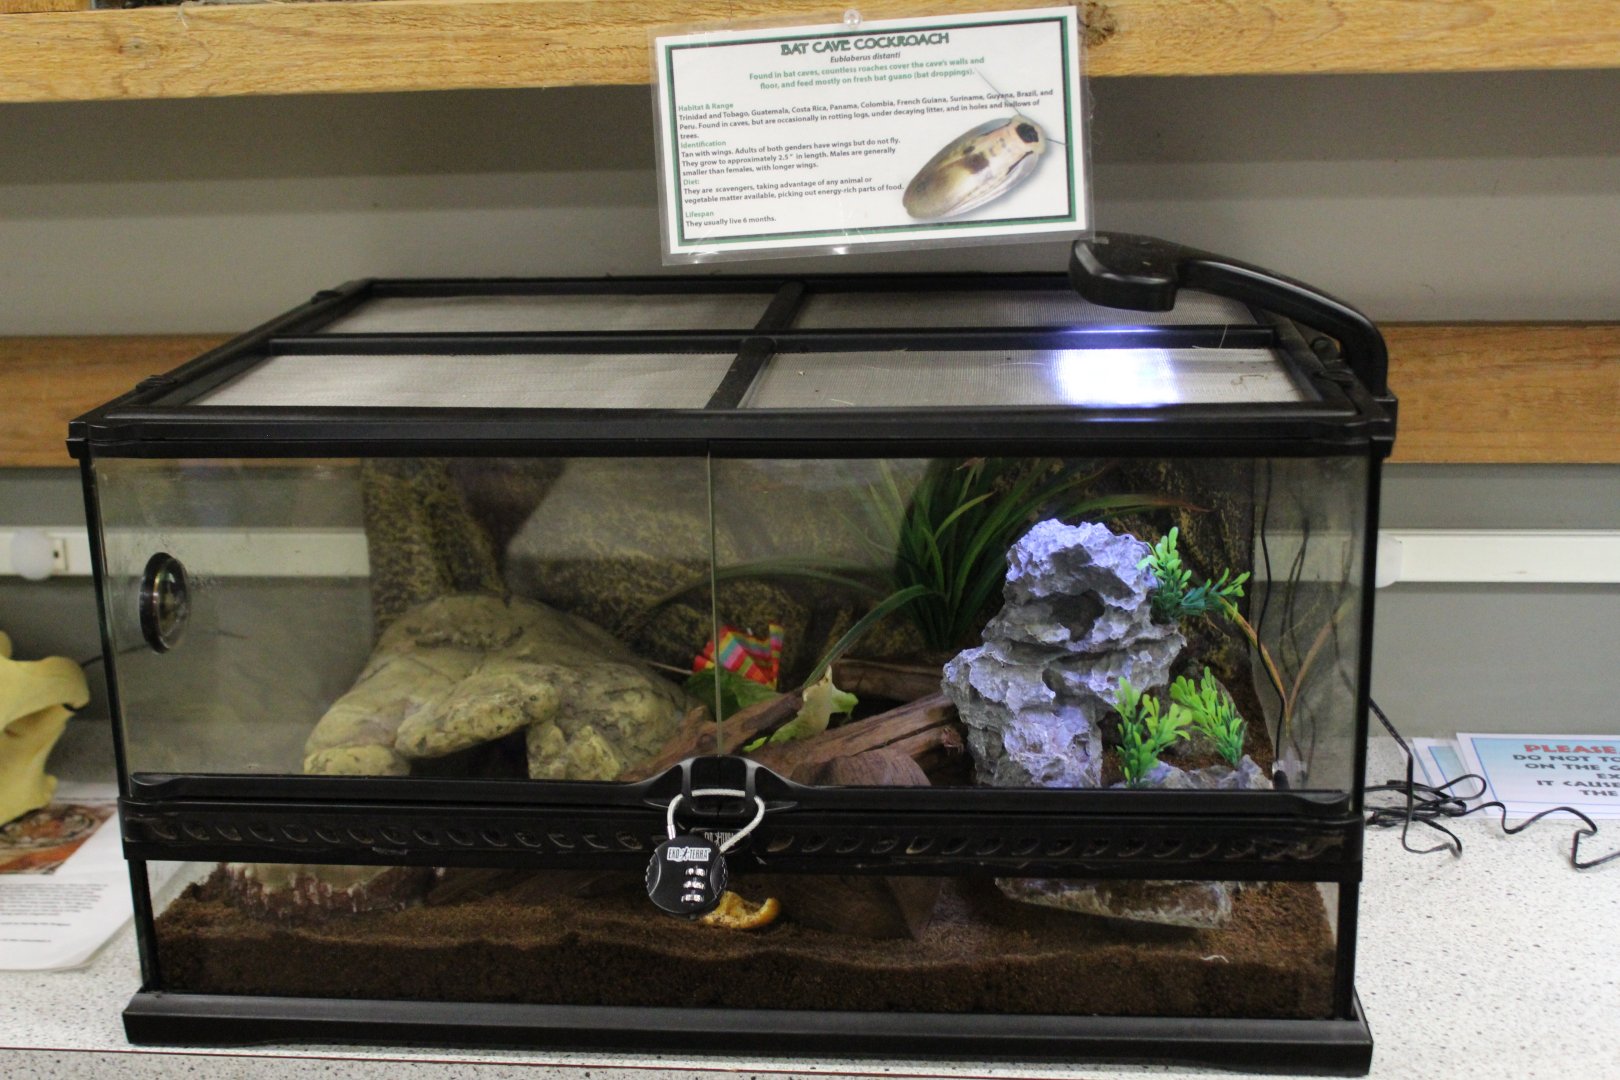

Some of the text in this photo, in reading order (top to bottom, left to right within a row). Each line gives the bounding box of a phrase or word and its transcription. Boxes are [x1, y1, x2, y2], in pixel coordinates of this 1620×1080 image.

[781, 32, 949, 55] BAT CAVE COCKROACH
[830, 51, 900, 63] Eublaberus distanti
[749, 71, 772, 80] Found
[783, 70, 795, 78] bat
[821, 66, 856, 75] countless
[858, 63, 887, 72] roaches
[911, 60, 923, 69] the
[925, 59, 947, 68] cave's
[949, 57, 967, 66] walls
[970, 56, 984, 65] and
[759, 81, 779, 89] floor,
[780, 79, 795, 88] and
[796, 78, 813, 87] feed
[814, 76, 840, 86] mostly
[853, 74, 872, 83] fresh
[873, 74, 886, 82] bat
[887, 73, 912, 83] guano
[913, 71, 929, 81] (bat
[930, 68, 974, 79] droppings).
[678, 104, 704, 112] Habitat
[712, 102, 734, 110] Range
[679, 112, 707, 120] Trinidad
[708, 111, 721, 119] and
[723, 110, 749, 118] Tobago,
[751, 106, 790, 116] Guatemala,
[812, 104, 828, 112] Rica,
[860, 100, 895, 108] Colombia,
[896, 97, 920, 106] French
[986, 93, 1014, 101] Guyana,
[1016, 90, 1037, 98] Brazil,
[1040, 88, 1053, 96] and
[698, 120, 720, 128] Found
[777, 114, 818, 123] occasionally
[828, 112, 852, 120] rotting
[853, 111, 869, 119] logs,
[871, 109, 891, 117] under
[893, 107, 924, 116] decaying
[946, 104, 959, 112] and
[969, 103, 987, 111] holes
[989, 101, 1002, 109] and
[680, 140, 727, 149] Identification
[694, 149, 710, 157] with
[711, 149, 733, 157] wings.
[734, 146, 757, 154] Adults
[758, 145, 765, 153] of
[766, 144, 783, 152] both
[784, 143, 812, 153] genders
[831, 141, 851, 149] wings
[852, 139, 865, 147] but
[866, 138, 875, 146] do
[889, 137, 900, 145] fly.
[682, 159, 698, 167] They
[699, 159, 717, 167] grow
[727, 154, 777, 165] approximately
[804, 150, 829, 160] length.
[830, 149, 850, 157] Males
[864, 146, 896, 157] generally
[682, 162, 819, 176] smaller than females, with longer wings.
[684, 187, 700, 195] They
[756, 182, 778, 190] taking
[779, 180, 816, 188] advantage
[817, 178, 825, 186] of
[839, 176, 863, 184] animal
[684, 194, 718, 204] vegetable
[743, 191, 776, 200] available,
[777, 190, 803, 199] picking
[818, 186, 857, 196] energy-rich
[858, 186, 876, 194] parts
[877, 184, 885, 192] of
[886, 183, 904, 191] food.
[685, 210, 714, 218] Lifespan
[686, 219, 703, 228] They
[704, 217, 728, 226] usually
[748, 215, 776, 223] months.
